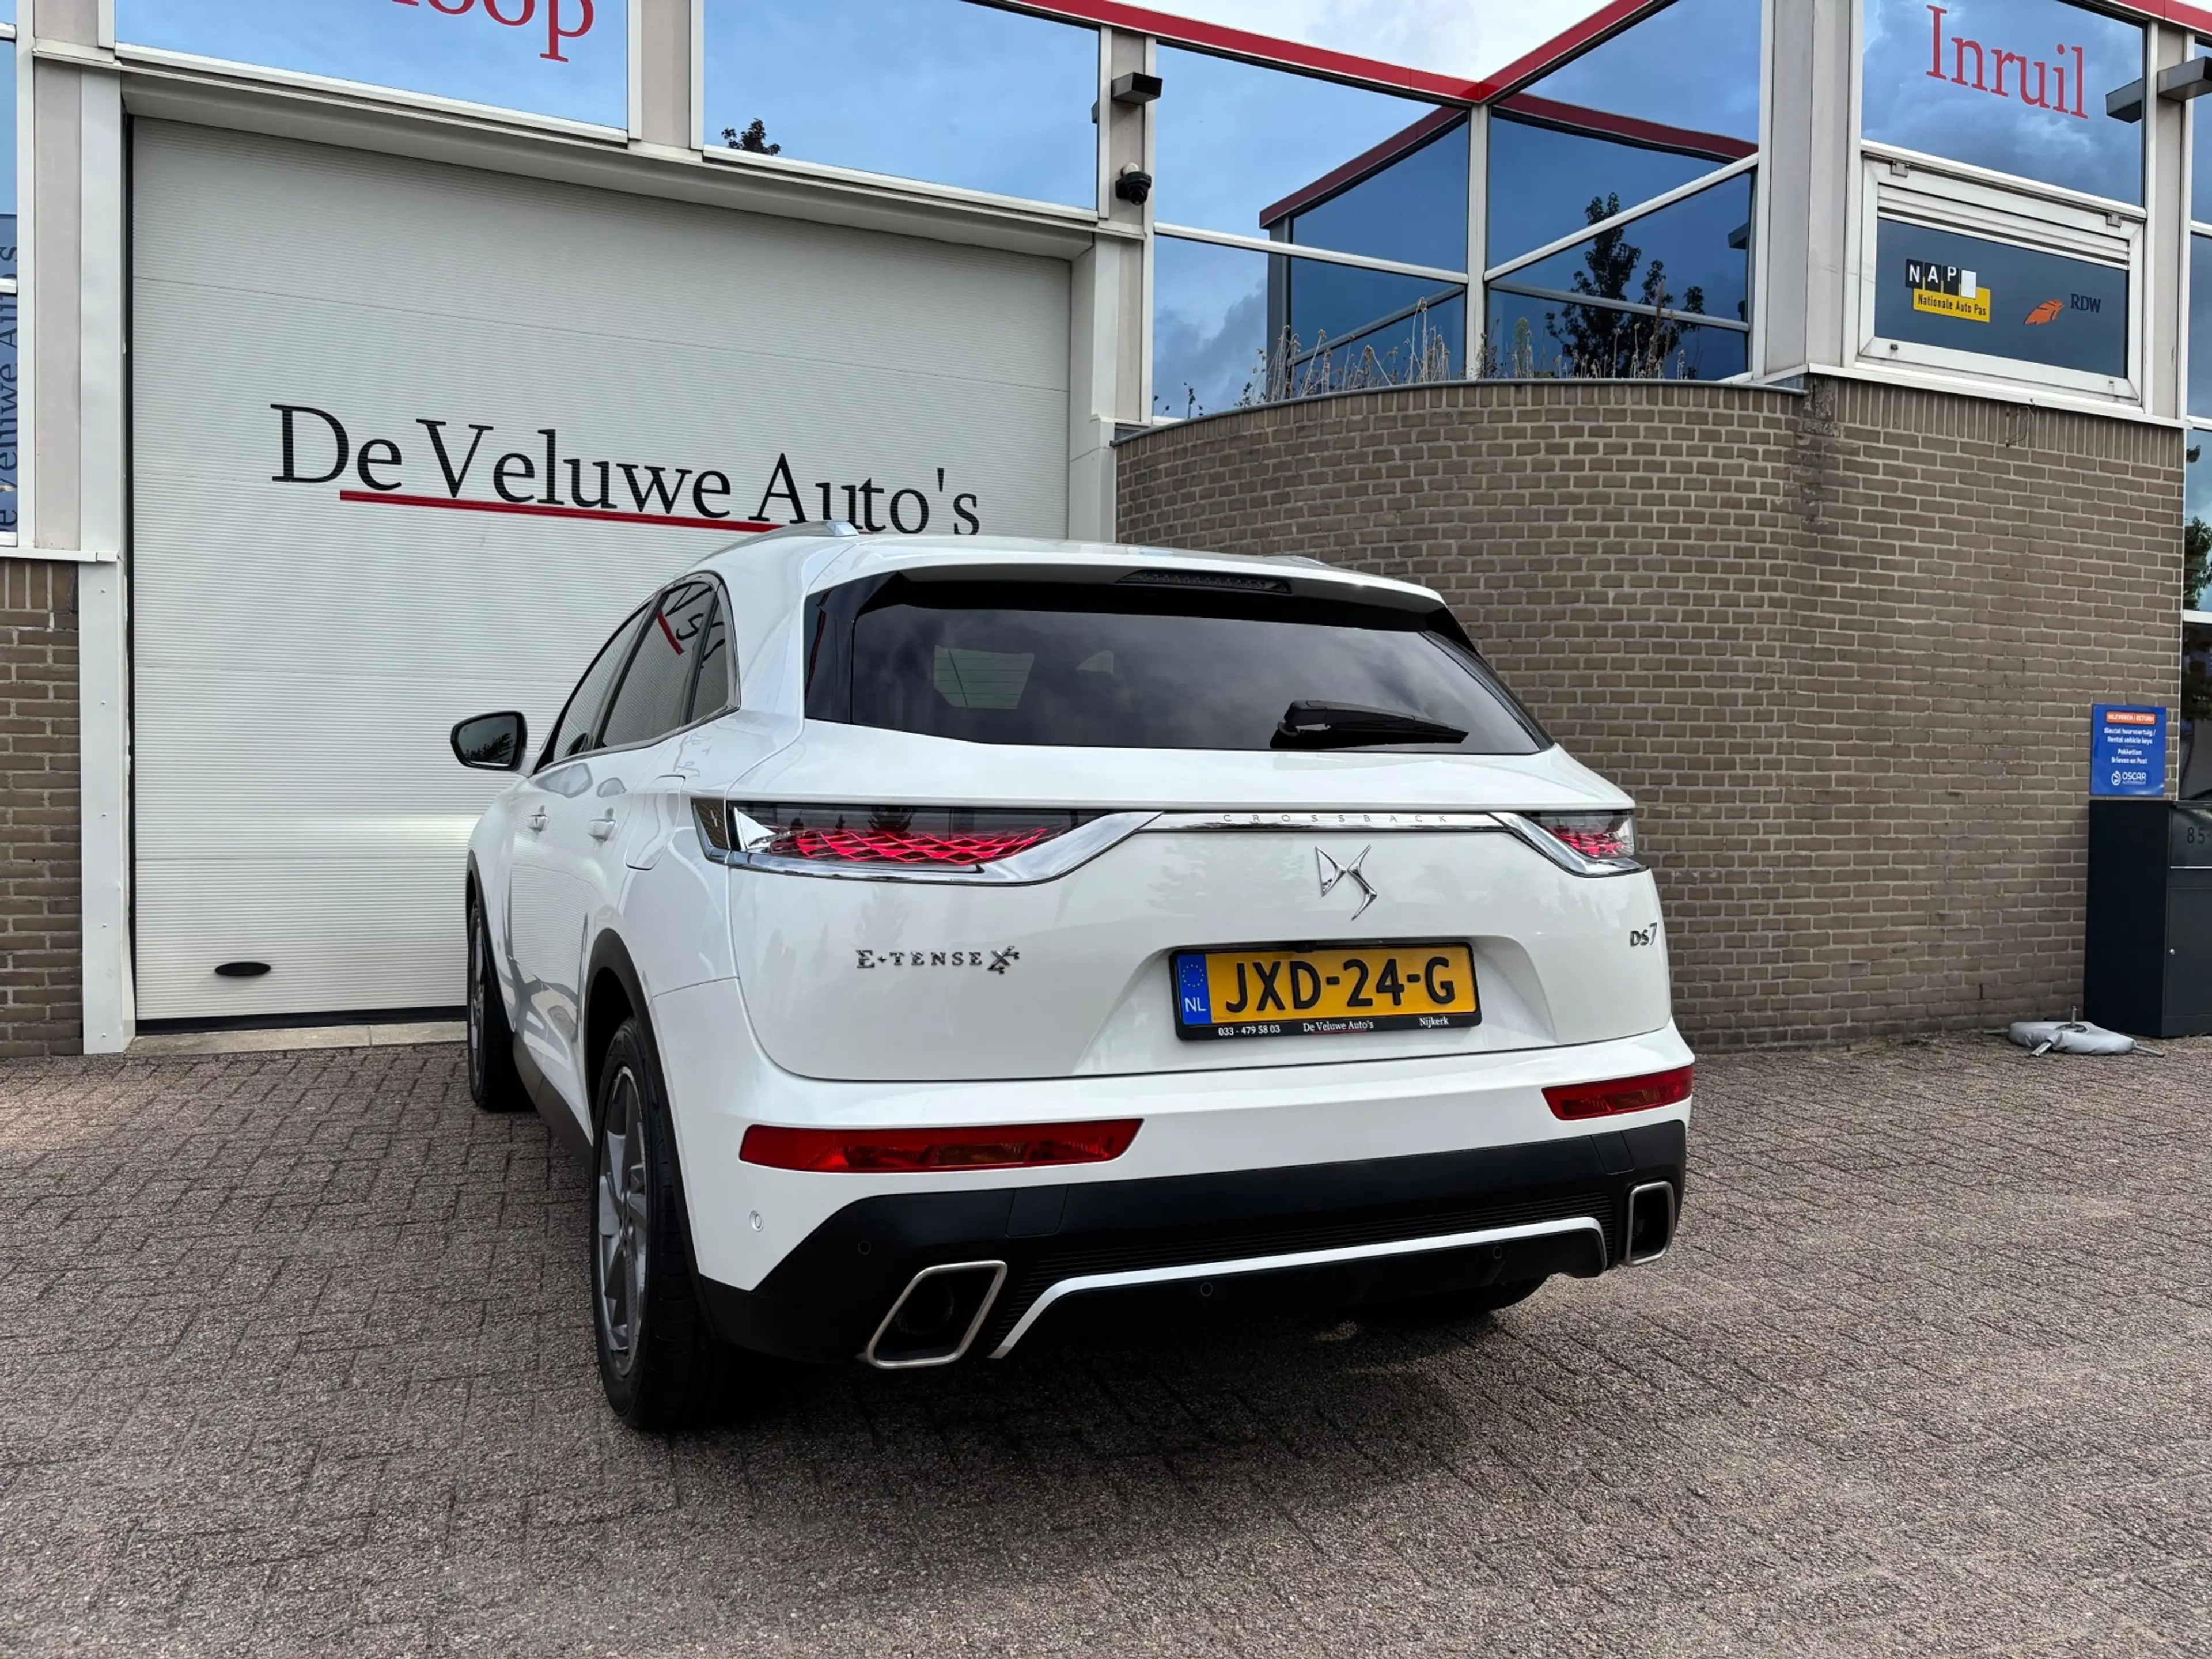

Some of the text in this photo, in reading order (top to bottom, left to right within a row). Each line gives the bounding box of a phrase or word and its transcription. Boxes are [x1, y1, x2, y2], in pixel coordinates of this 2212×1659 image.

[1926, 5, 2088, 119] Inruil
[1908, 264, 1957, 284] NAP
[1918, 293, 1987, 316] Nationale Auto Pas
[2070, 293, 2101, 313] RDW
[270, 403, 980, 535] De Veluwe Auto's
[2122, 772, 2147, 780] OSCAR
[1222, 813, 1448, 823] CROSSBACK
[1184, 957, 1456, 1013] NL JXD-24-G
[1218, 1027, 1234, 1036] 033
[1241, 1025, 1257, 1035] 479
[1258, 1025, 1268, 1035] 58
[1270, 1024, 1281, 1034] 03
[1302, 1022, 1315, 1032] De
[1316, 1021, 1347, 1031] Veluwe
[1348, 1020, 1374, 1030] Auto's
[1419, 1016, 1449, 1028] Nijkerk
